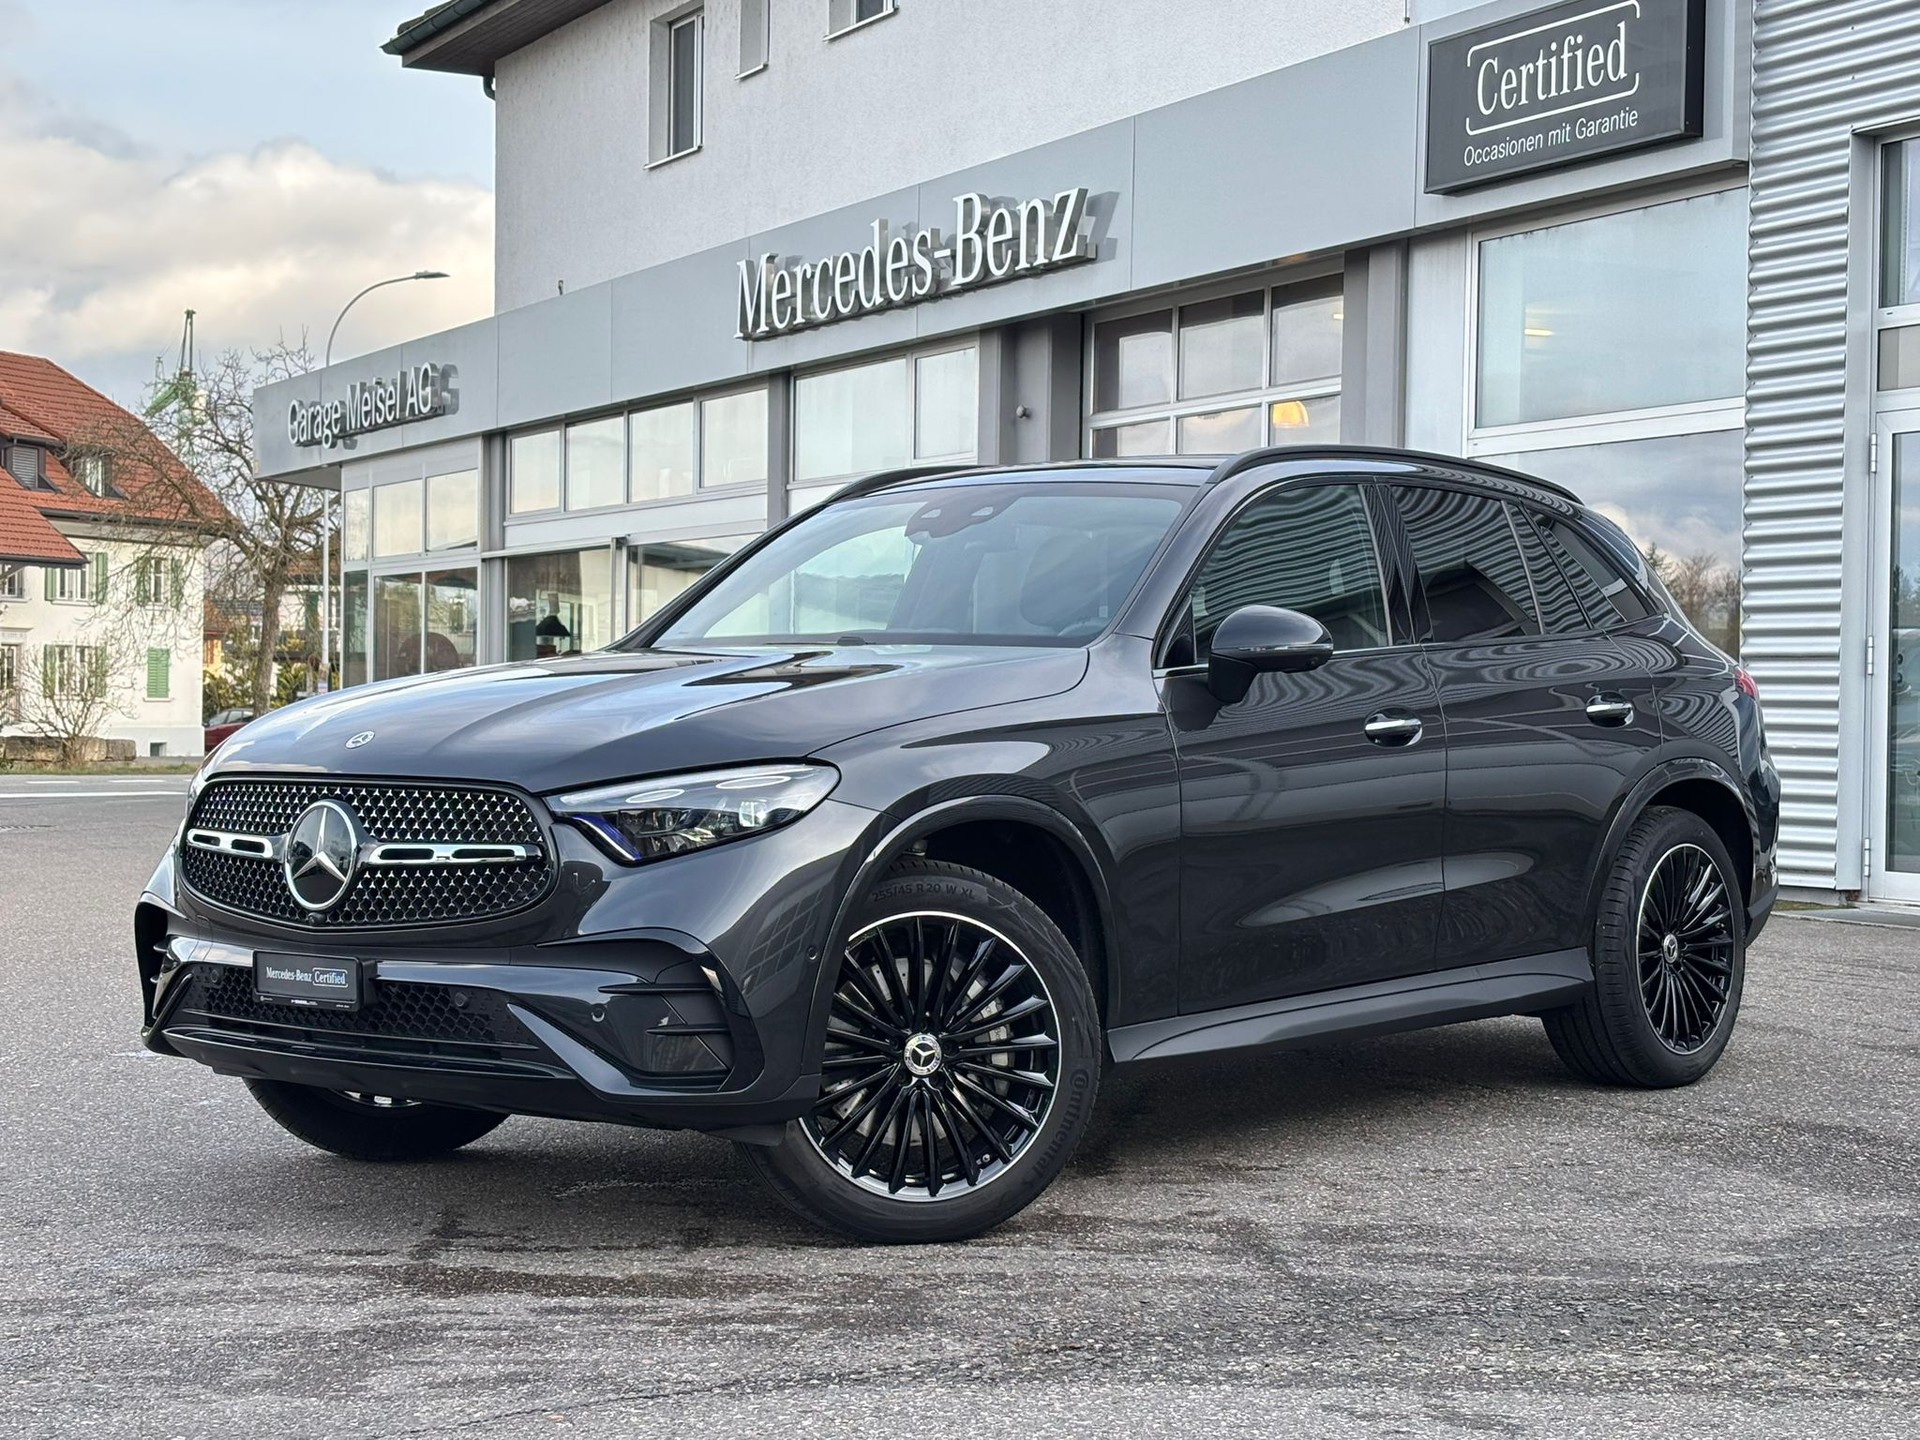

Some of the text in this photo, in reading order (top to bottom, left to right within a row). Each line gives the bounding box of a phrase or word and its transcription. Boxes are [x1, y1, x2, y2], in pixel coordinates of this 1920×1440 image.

[1477, 20, 1628, 116] Certified
[1464, 107, 1639, 167] Occasionen mit Garantie
[734, 187, 1092, 340] Mercedes-Benz
[288, 362, 433, 449] Garage Meisel AG
[961, 887, 975, 899] XL
[266, 966, 346, 985] Mercedes-Benz Certified
[1032, 1068, 1089, 1177] Continental
